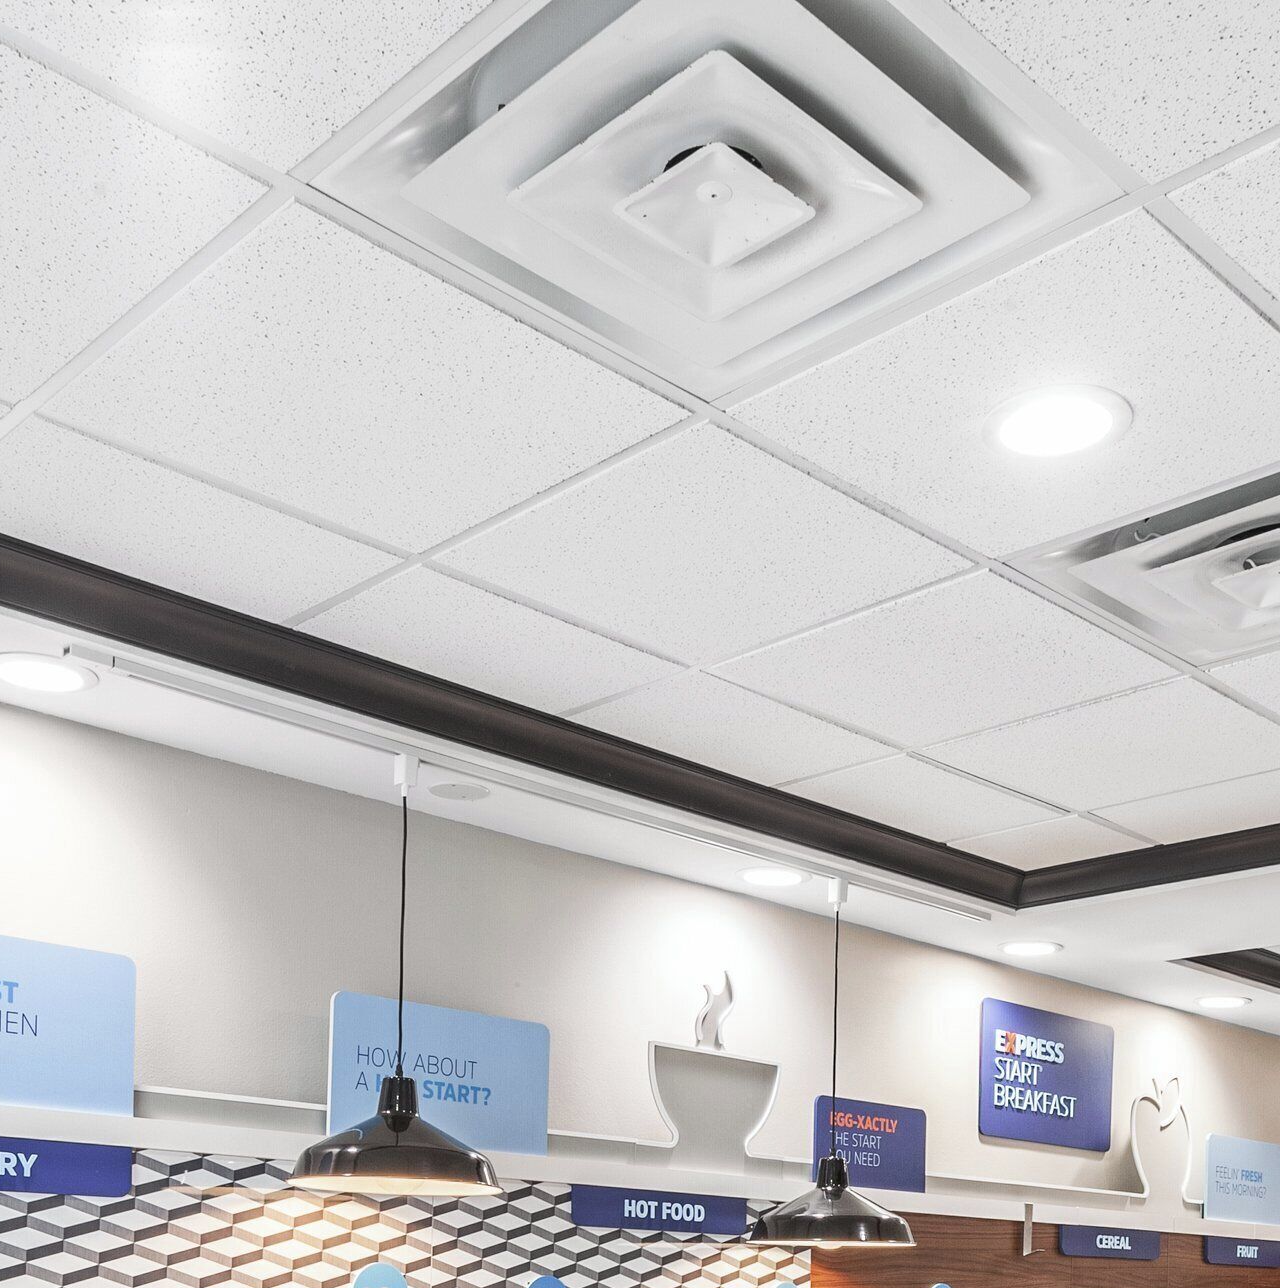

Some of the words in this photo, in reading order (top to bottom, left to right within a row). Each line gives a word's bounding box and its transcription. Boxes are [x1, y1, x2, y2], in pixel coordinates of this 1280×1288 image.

[995, 1029, 1065, 1064] EXPRESS
[356, 1045, 407, 1069] HOW
[413, 1053, 478, 1080] ABOUT
[355, 1071, 369, 1091] A
[422, 1079, 492, 1106] START?
[993, 1083, 1077, 1118] BREAKFAST
[829, 1111, 898, 1134] EGG-XACTLY
[852, 1133, 882, 1150] START
[829, 1148, 851, 1164] OU
[854, 1151, 881, 1167] NEED
[1240, 1169, 1263, 1183] FRESH
[1215, 1180, 1231, 1195] THIS
[1232, 1183, 1267, 1199] MORNING?
[624, 1199, 658, 1219] HOT
[662, 1202, 705, 1222] FOOD
[1096, 1234, 1132, 1250] CEREAL
[1236, 1245, 1259, 1259] FRUIT
